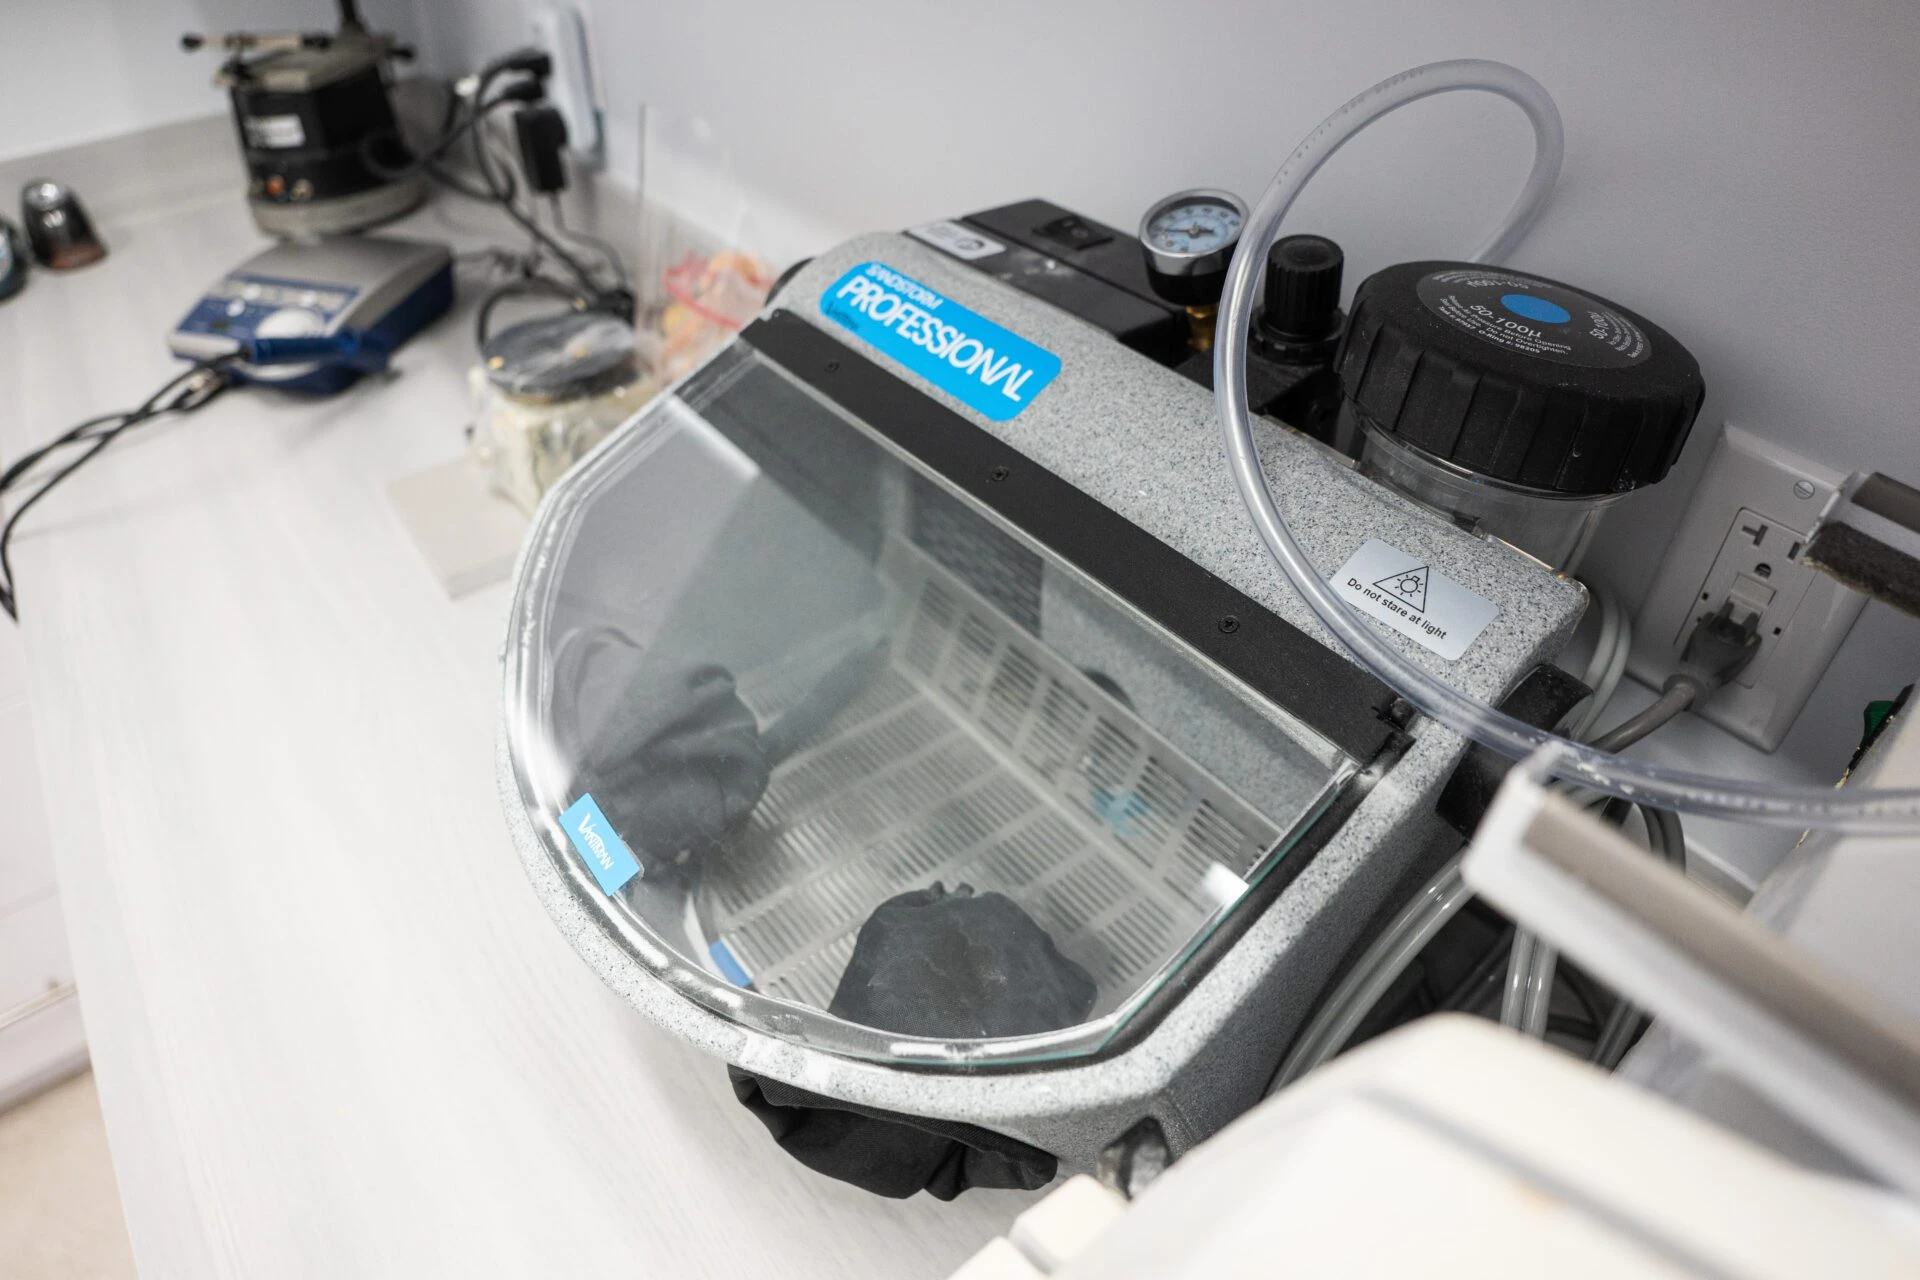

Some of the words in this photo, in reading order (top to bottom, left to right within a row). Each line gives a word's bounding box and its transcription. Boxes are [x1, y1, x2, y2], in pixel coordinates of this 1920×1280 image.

[865, 263, 943, 310] SANDSTORM
[836, 275, 1034, 402] PROFESSIONAL
[1486, 327, 1498, 335] Do
[1499, 333, 1514, 341] not
[1504, 329, 1533, 341] Before
[1534, 338, 1572, 351] Opening
[1347, 577, 1362, 590] Do
[1363, 587, 1382, 602] not
[1381, 597, 1408, 617] stare
[1408, 614, 1422, 625] at
[1421, 619, 1447, 640] light
